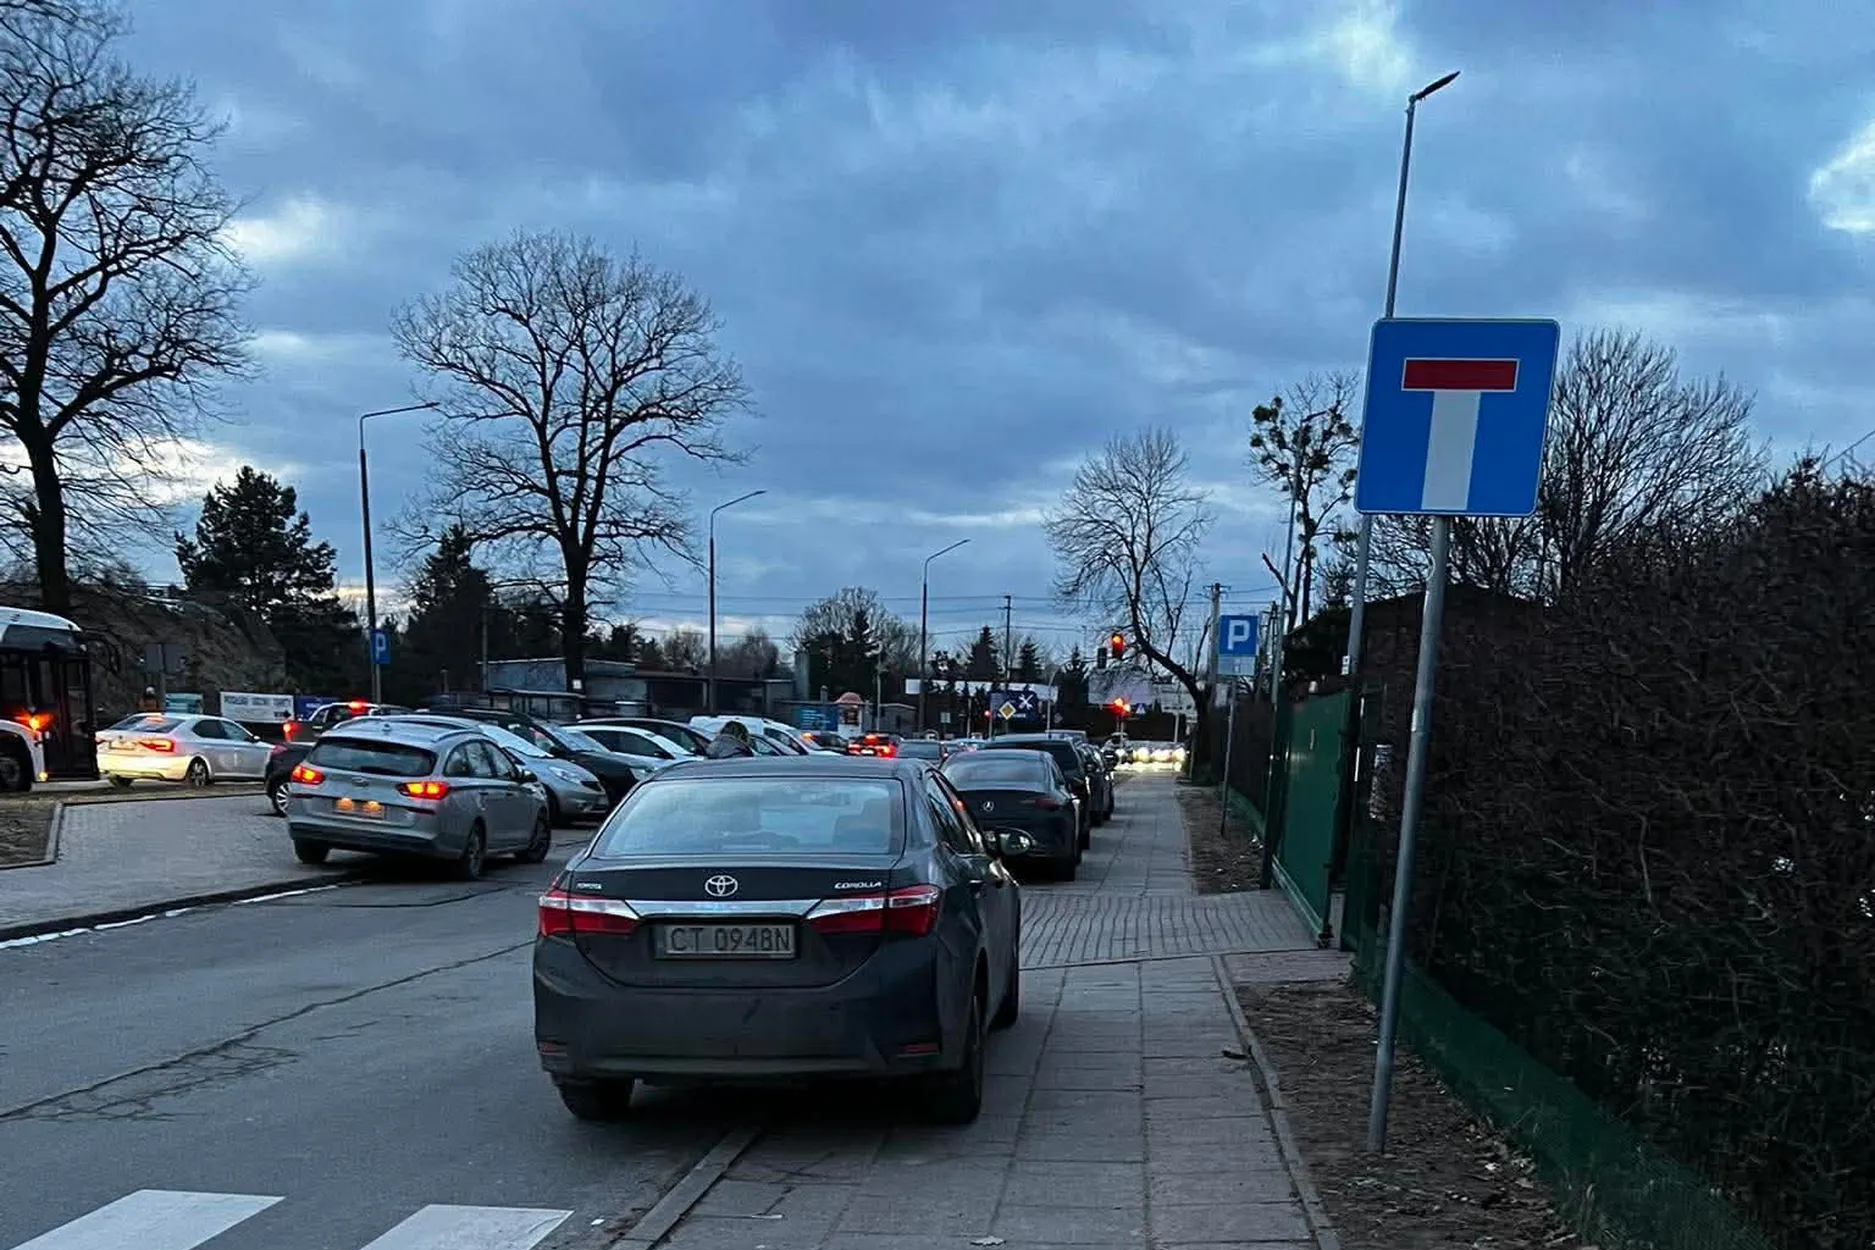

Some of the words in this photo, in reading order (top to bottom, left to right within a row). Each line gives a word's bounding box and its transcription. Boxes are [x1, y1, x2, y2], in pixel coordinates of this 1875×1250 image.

[375, 633, 386, 660] P
[1228, 620, 1250, 650] P
[834, 881, 882, 889] COROLLA
[670, 927, 704, 951] CT
